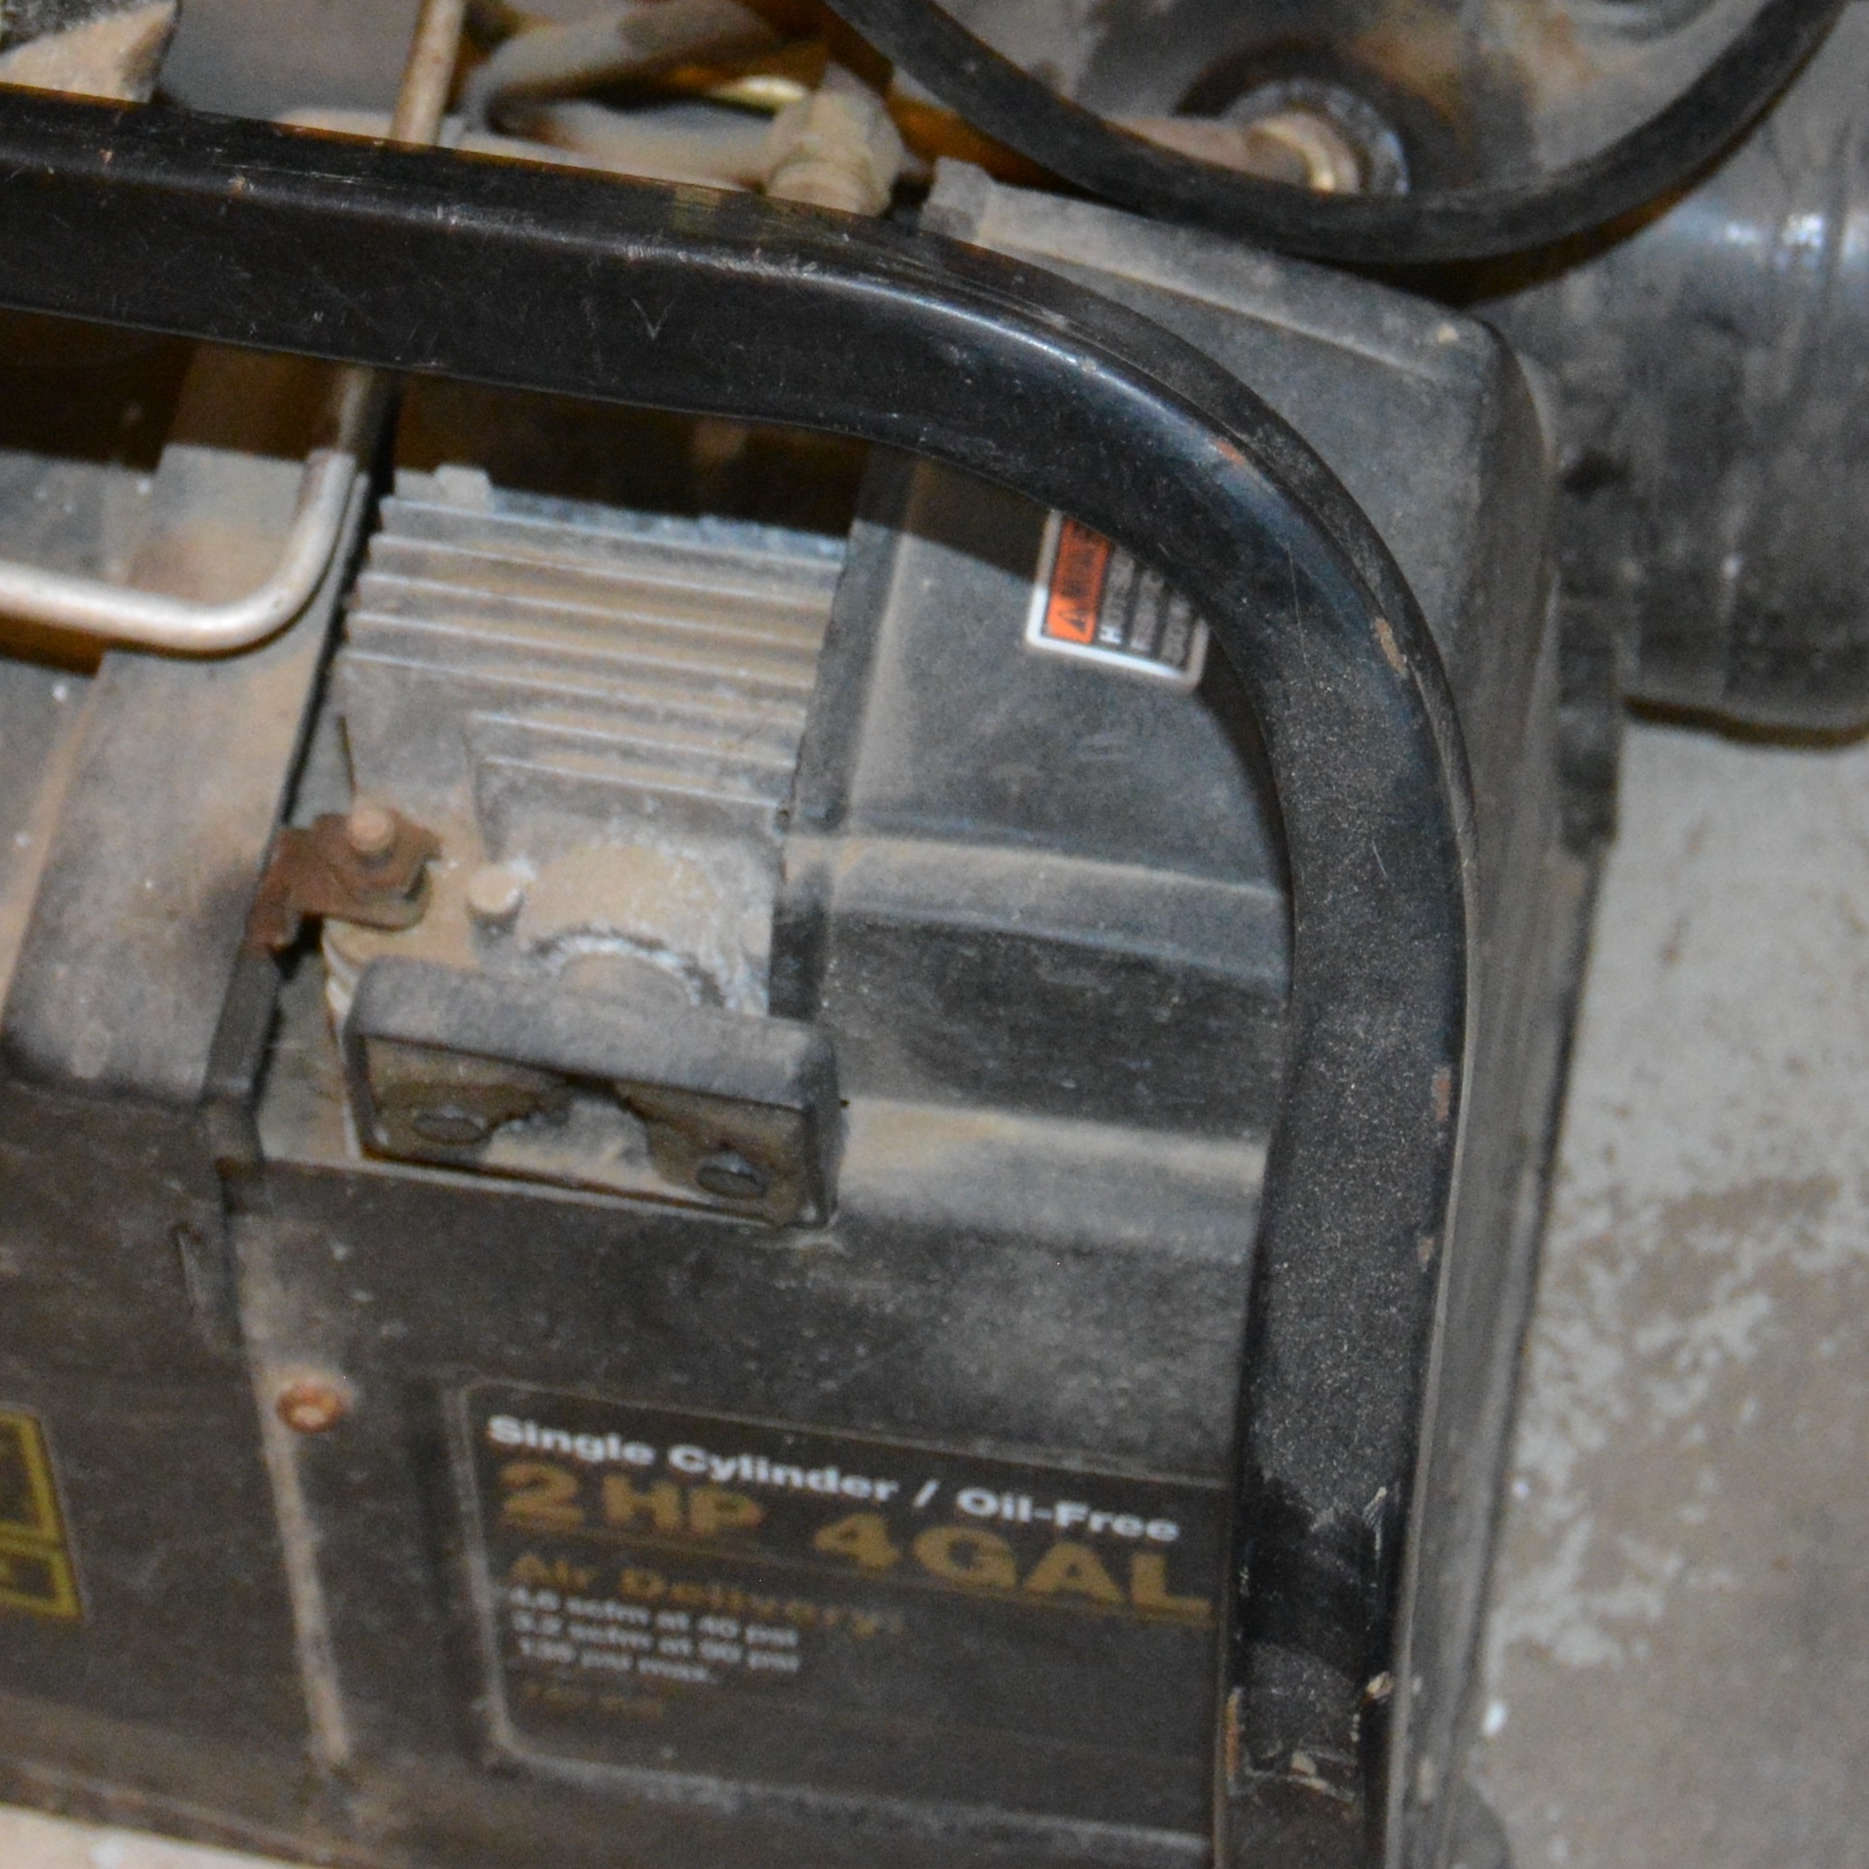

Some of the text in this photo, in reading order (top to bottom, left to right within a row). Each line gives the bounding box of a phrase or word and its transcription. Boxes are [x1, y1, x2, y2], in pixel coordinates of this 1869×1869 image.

[487, 1414, 655, 1465] Single
[667, 1443, 900, 1502] Cylinder
[955, 1486, 1181, 1543] Oil-Free
